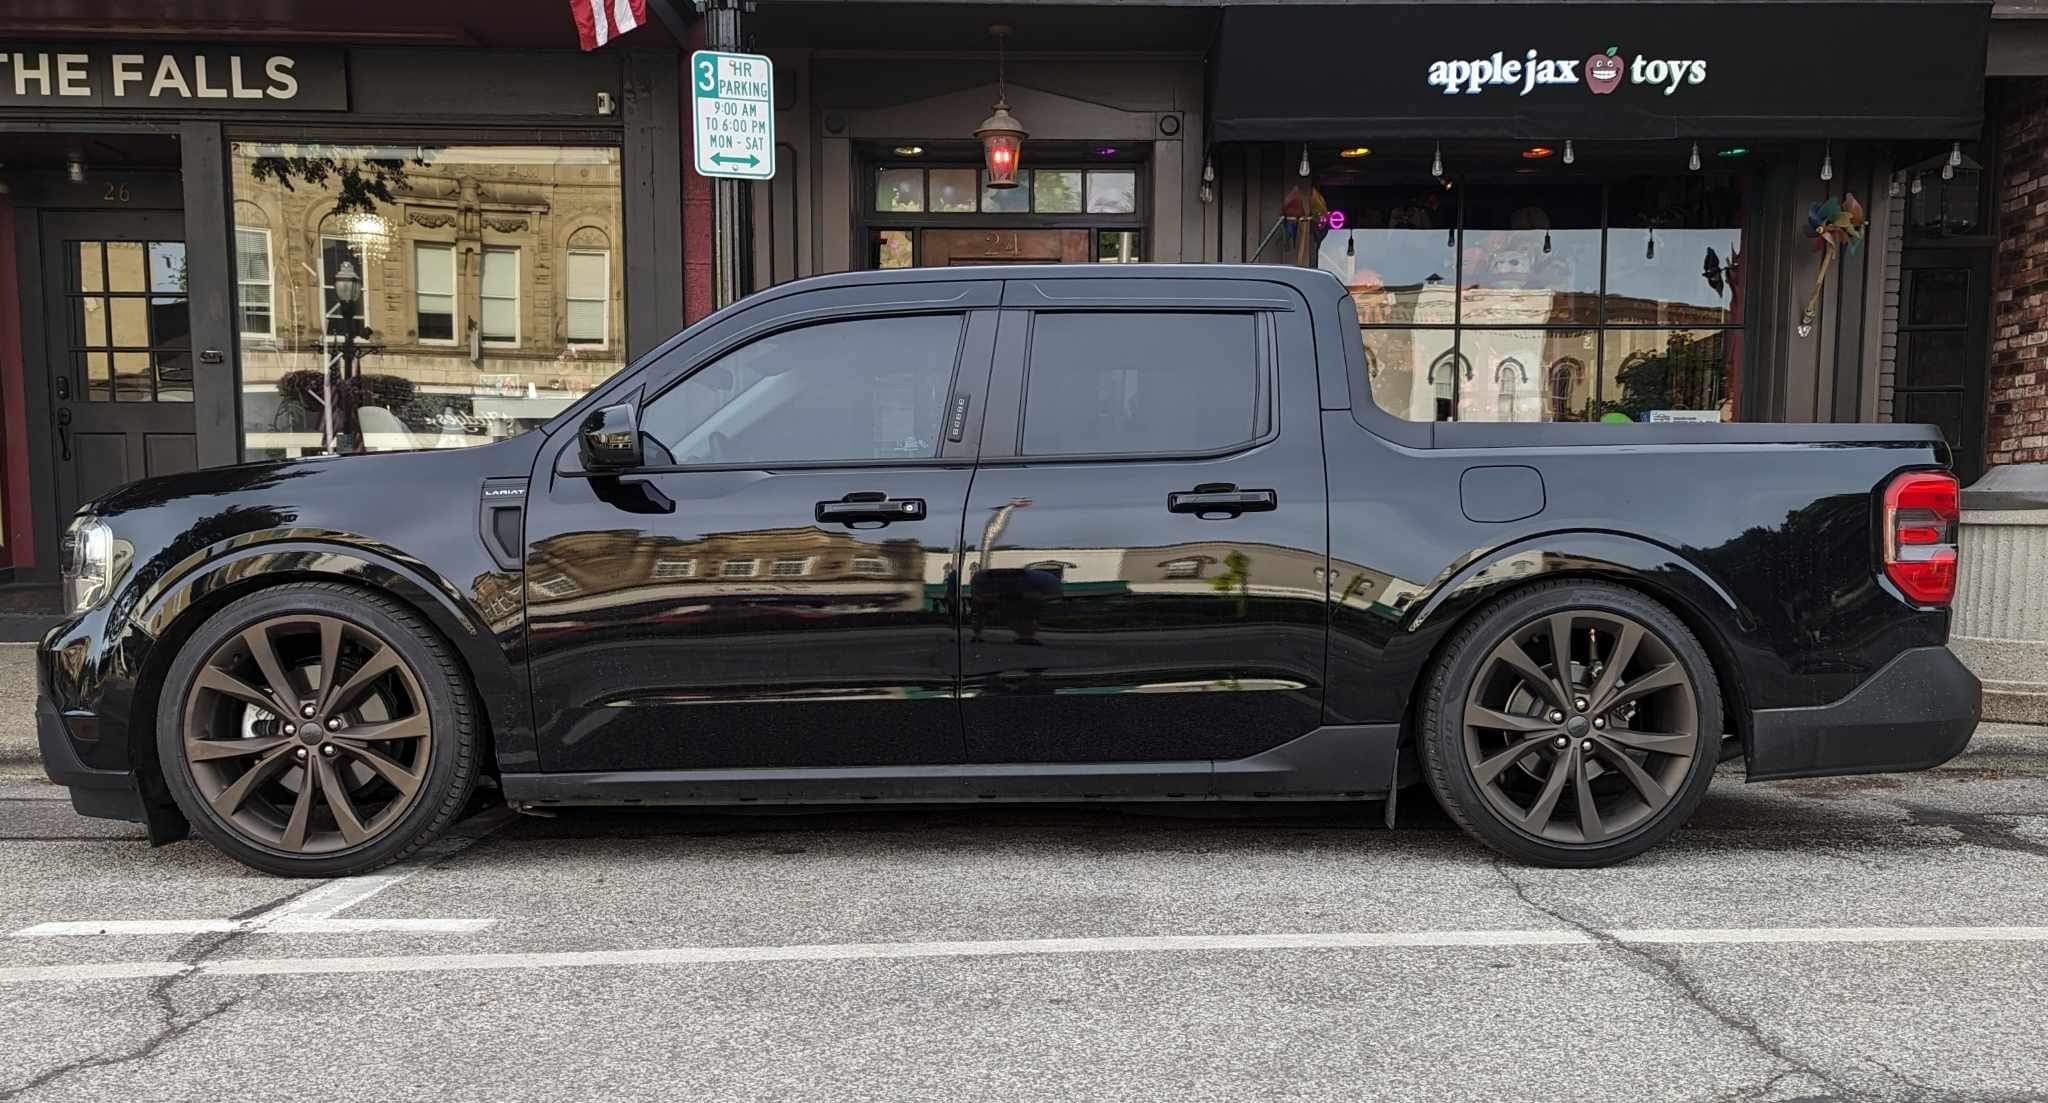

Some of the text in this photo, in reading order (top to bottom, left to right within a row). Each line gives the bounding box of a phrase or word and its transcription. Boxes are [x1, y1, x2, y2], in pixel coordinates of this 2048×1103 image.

[112, 54, 299, 99] FALLS
[698, 61, 752, 91] 3 HR
[1630, 54, 1708, 96] toys
[719, 80, 768, 97] PARKING
[714, 102, 757, 116] 9:00 AM
[706, 117, 766, 134] TO 6:00 PM
[710, 134, 732, 148] MON
[745, 137, 764, 150] SAT
[103, 181, 130, 202] 26
[984, 232, 1023, 256] 24
